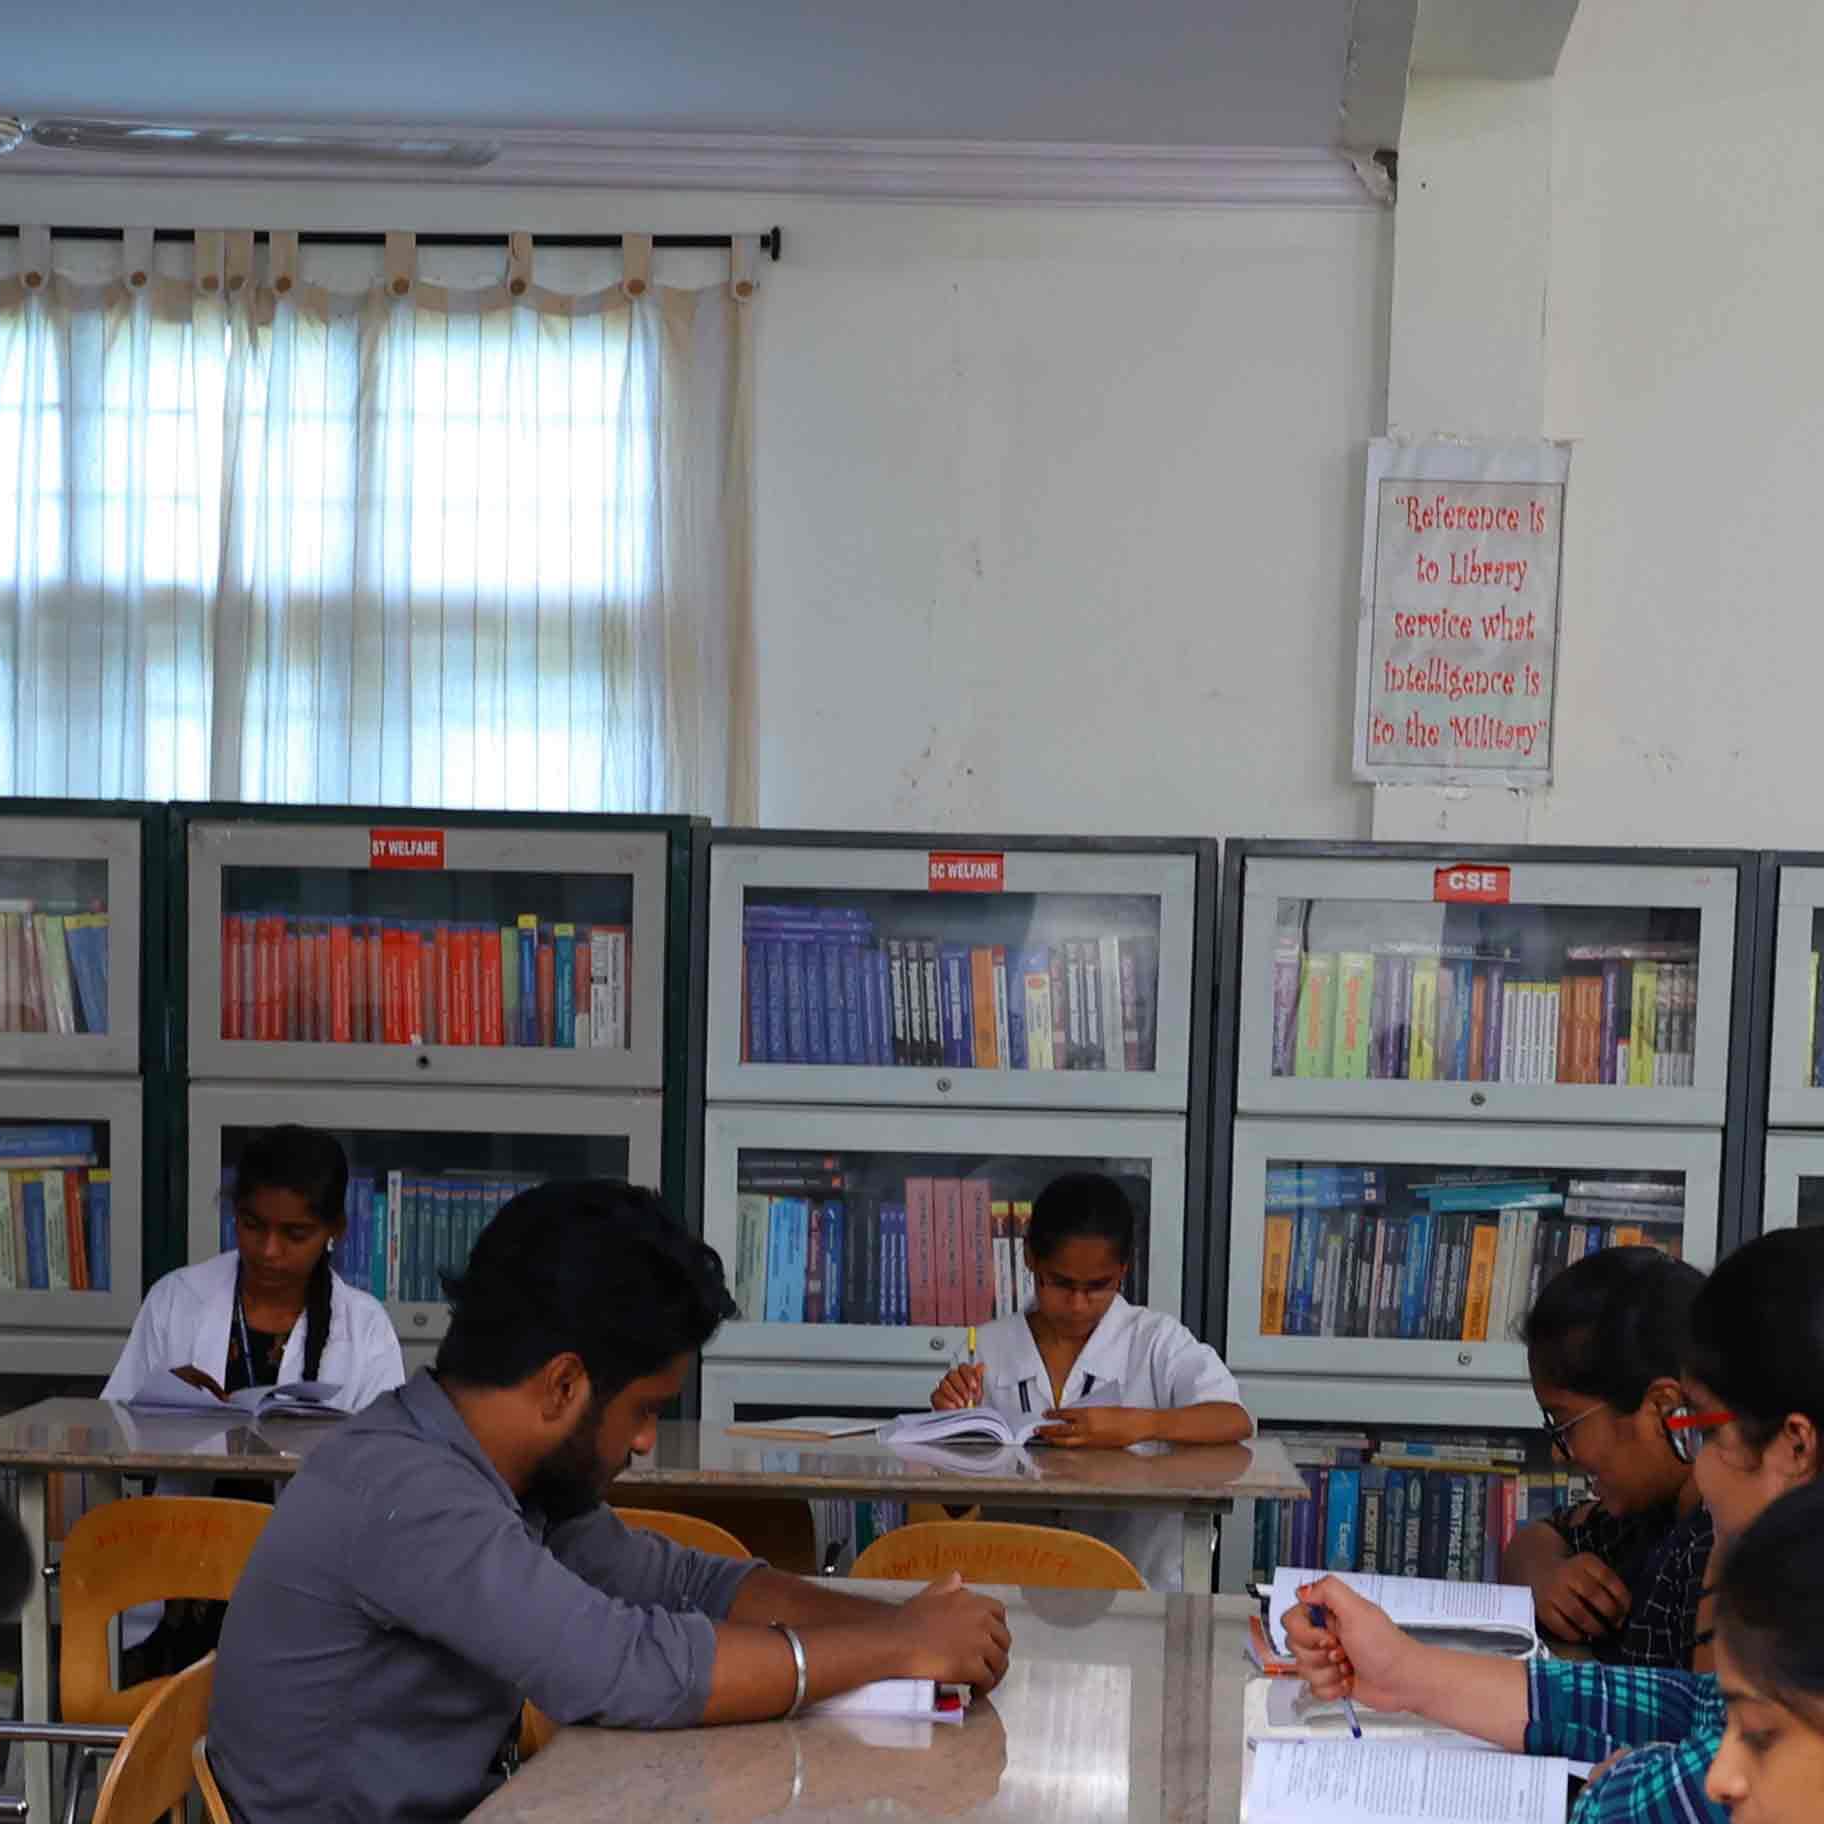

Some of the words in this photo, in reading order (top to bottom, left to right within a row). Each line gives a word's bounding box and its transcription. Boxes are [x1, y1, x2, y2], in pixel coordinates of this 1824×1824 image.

[1528, 501, 1545, 534] is
[1416, 551, 1439, 584] to
[1449, 546, 1528, 592] Library
[1394, 608, 1472, 640] service
[1481, 605, 1536, 641] what
[1383, 657, 1515, 701] intelligence
[1523, 664, 1542, 696] is
[1373, 711, 1395, 745] to
[1406, 710, 1440, 748] the
[388, 840, 438, 856] WELFARE
[947, 863, 997, 880] WELFARE
[1448, 872, 1497, 891] CSE
